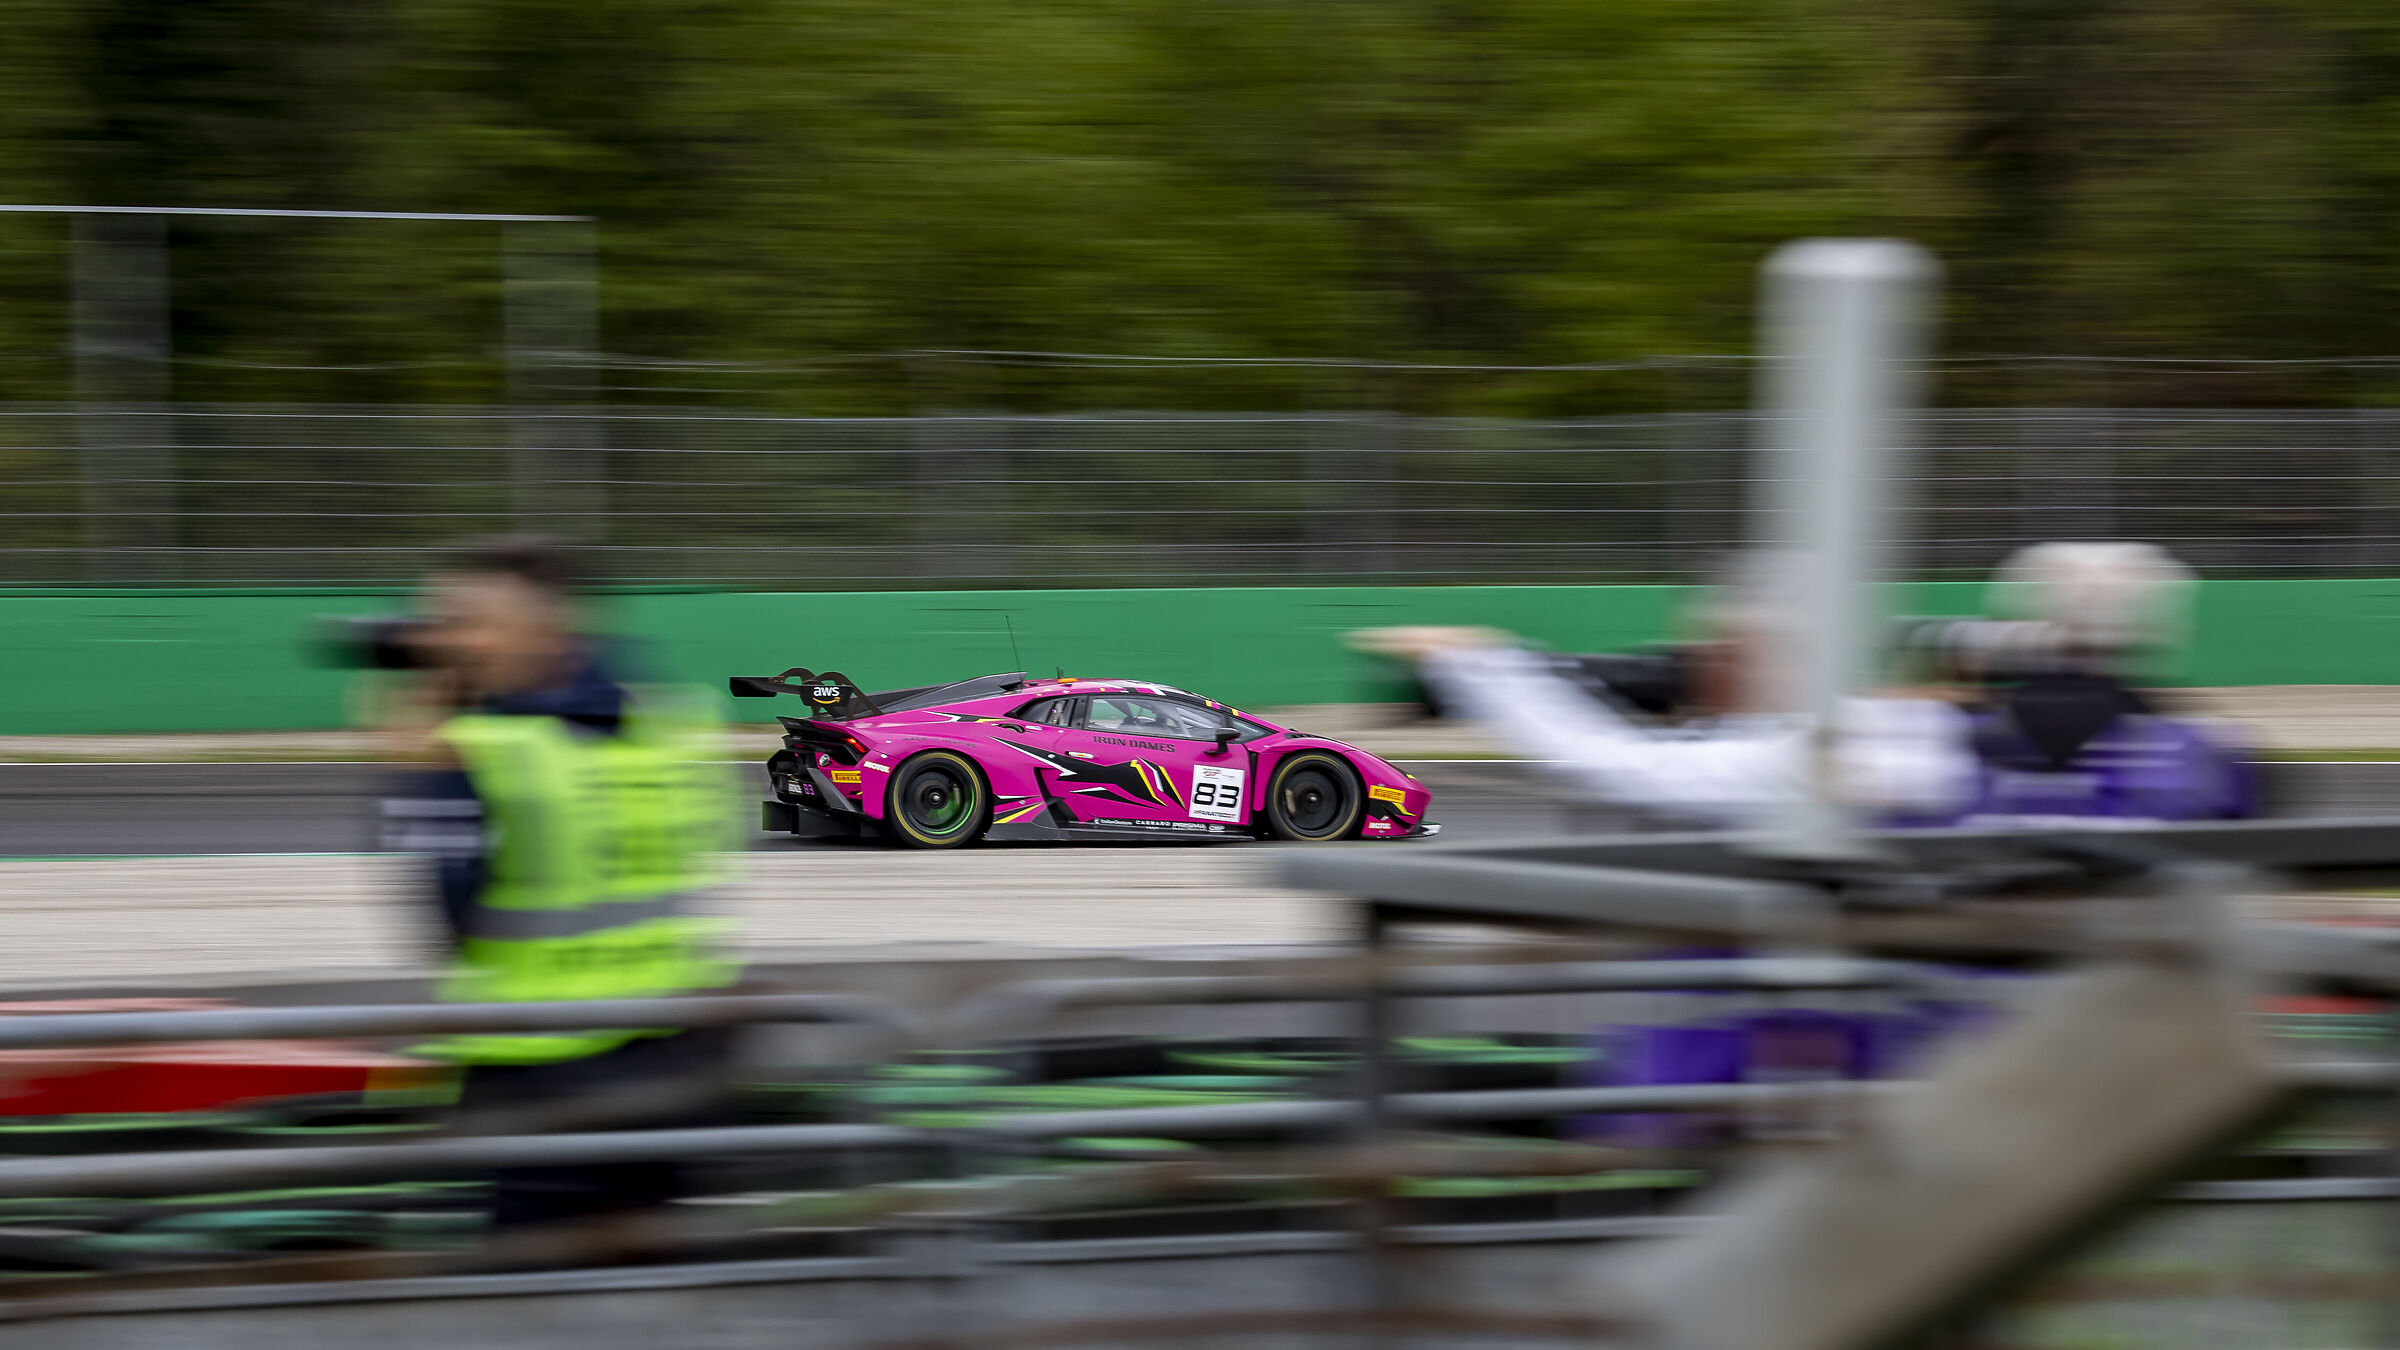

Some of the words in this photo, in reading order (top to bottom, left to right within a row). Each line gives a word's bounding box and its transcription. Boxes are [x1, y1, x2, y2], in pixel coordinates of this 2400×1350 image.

[813, 686, 840, 697] aws
[1093, 735, 1126, 747] IRON
[1129, 740, 1175, 752] DAMES
[1194, 782, 1240, 808] 83
